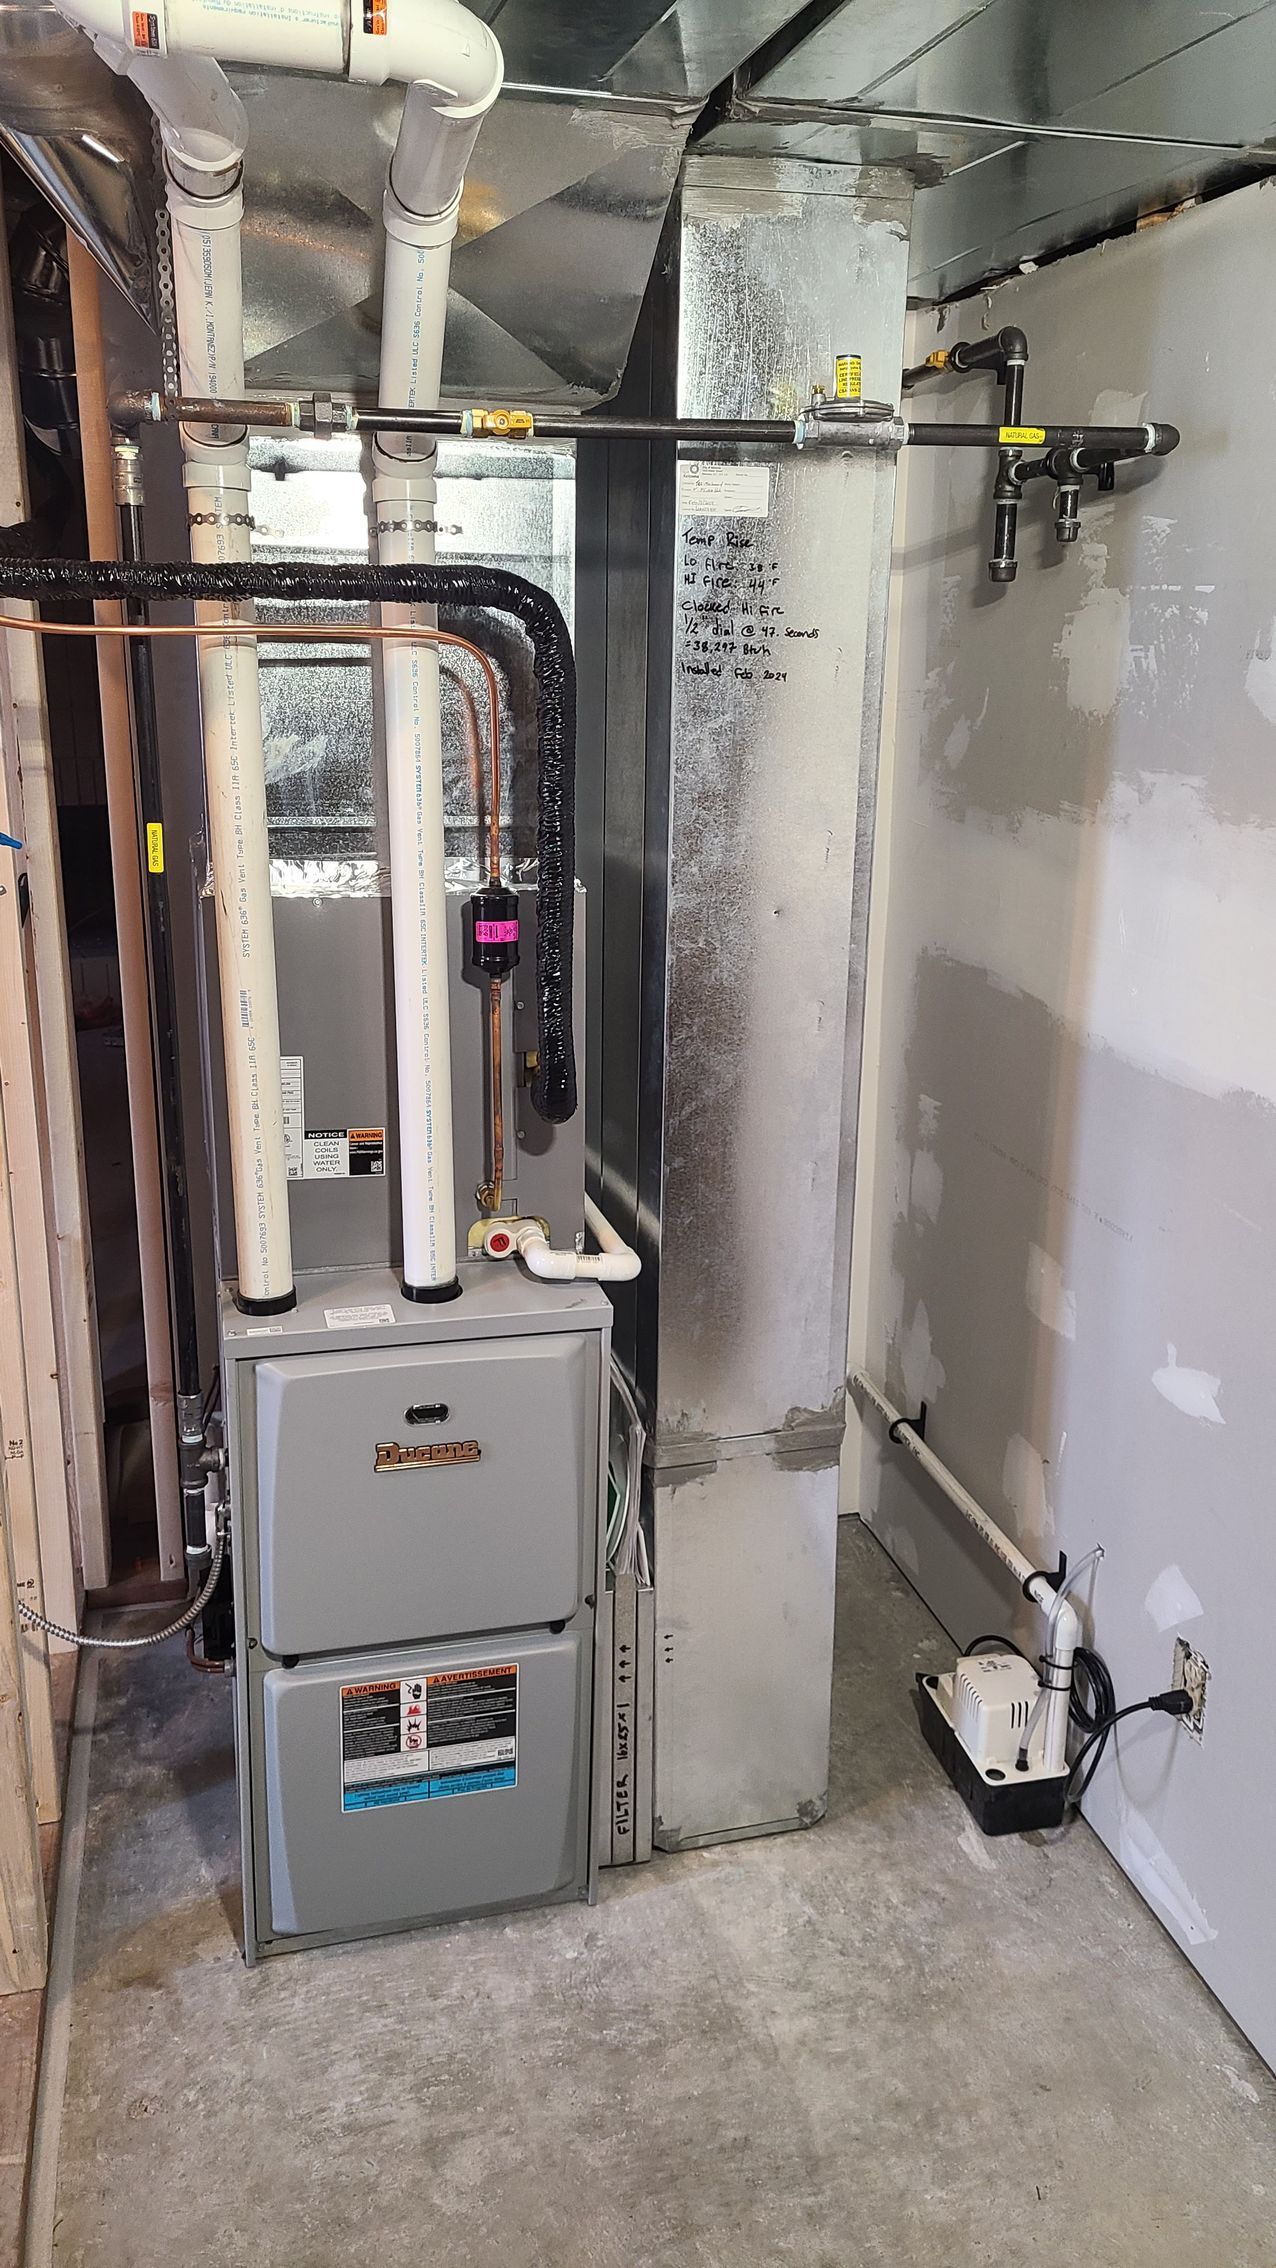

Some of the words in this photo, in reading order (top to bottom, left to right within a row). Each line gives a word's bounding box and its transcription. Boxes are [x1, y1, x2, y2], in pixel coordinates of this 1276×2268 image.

[414, 286, 424, 317] Control
[411, 343, 420, 356] ULC
[409, 356, 419, 385] Listed
[1005, 431, 1029, 440] NATURAL
[1028, 432, 1040, 440] GAS
[682, 527, 715, 547] Temp
[726, 532, 754, 548] Rise
[748, 578, 765, 595] 44
[681, 600, 731, 615] Clocked
[712, 618, 734, 636] dial
[741, 625, 756, 637] @
[225, 654, 233, 674] ULC
[681, 661, 722, 677] Installed
[763, 670, 788, 682] 2024
[226, 674, 236, 707] Listed
[412, 681, 420, 712] Control
[229, 712, 238, 751] Intertek
[233, 796, 244, 821] Class
[151, 829, 159, 855] NATURAL
[152, 855, 160, 867] GAS
[239, 888, 247, 903] Gas
[241, 928, 251, 958] SYSTEM
[250, 1073, 259, 1097] Class
[356, 1131, 383, 1139] WARNING
[256, 1191, 266, 1219] SYSTEM
[258, 1222, 268, 1254] 5007693
[375, 1440, 479, 1467] Ducane
[440, 1666, 512, 1683] AVERTISSEMENT
[354, 1682, 396, 1695] WARNING
[615, 1774, 630, 1835] FILTER
